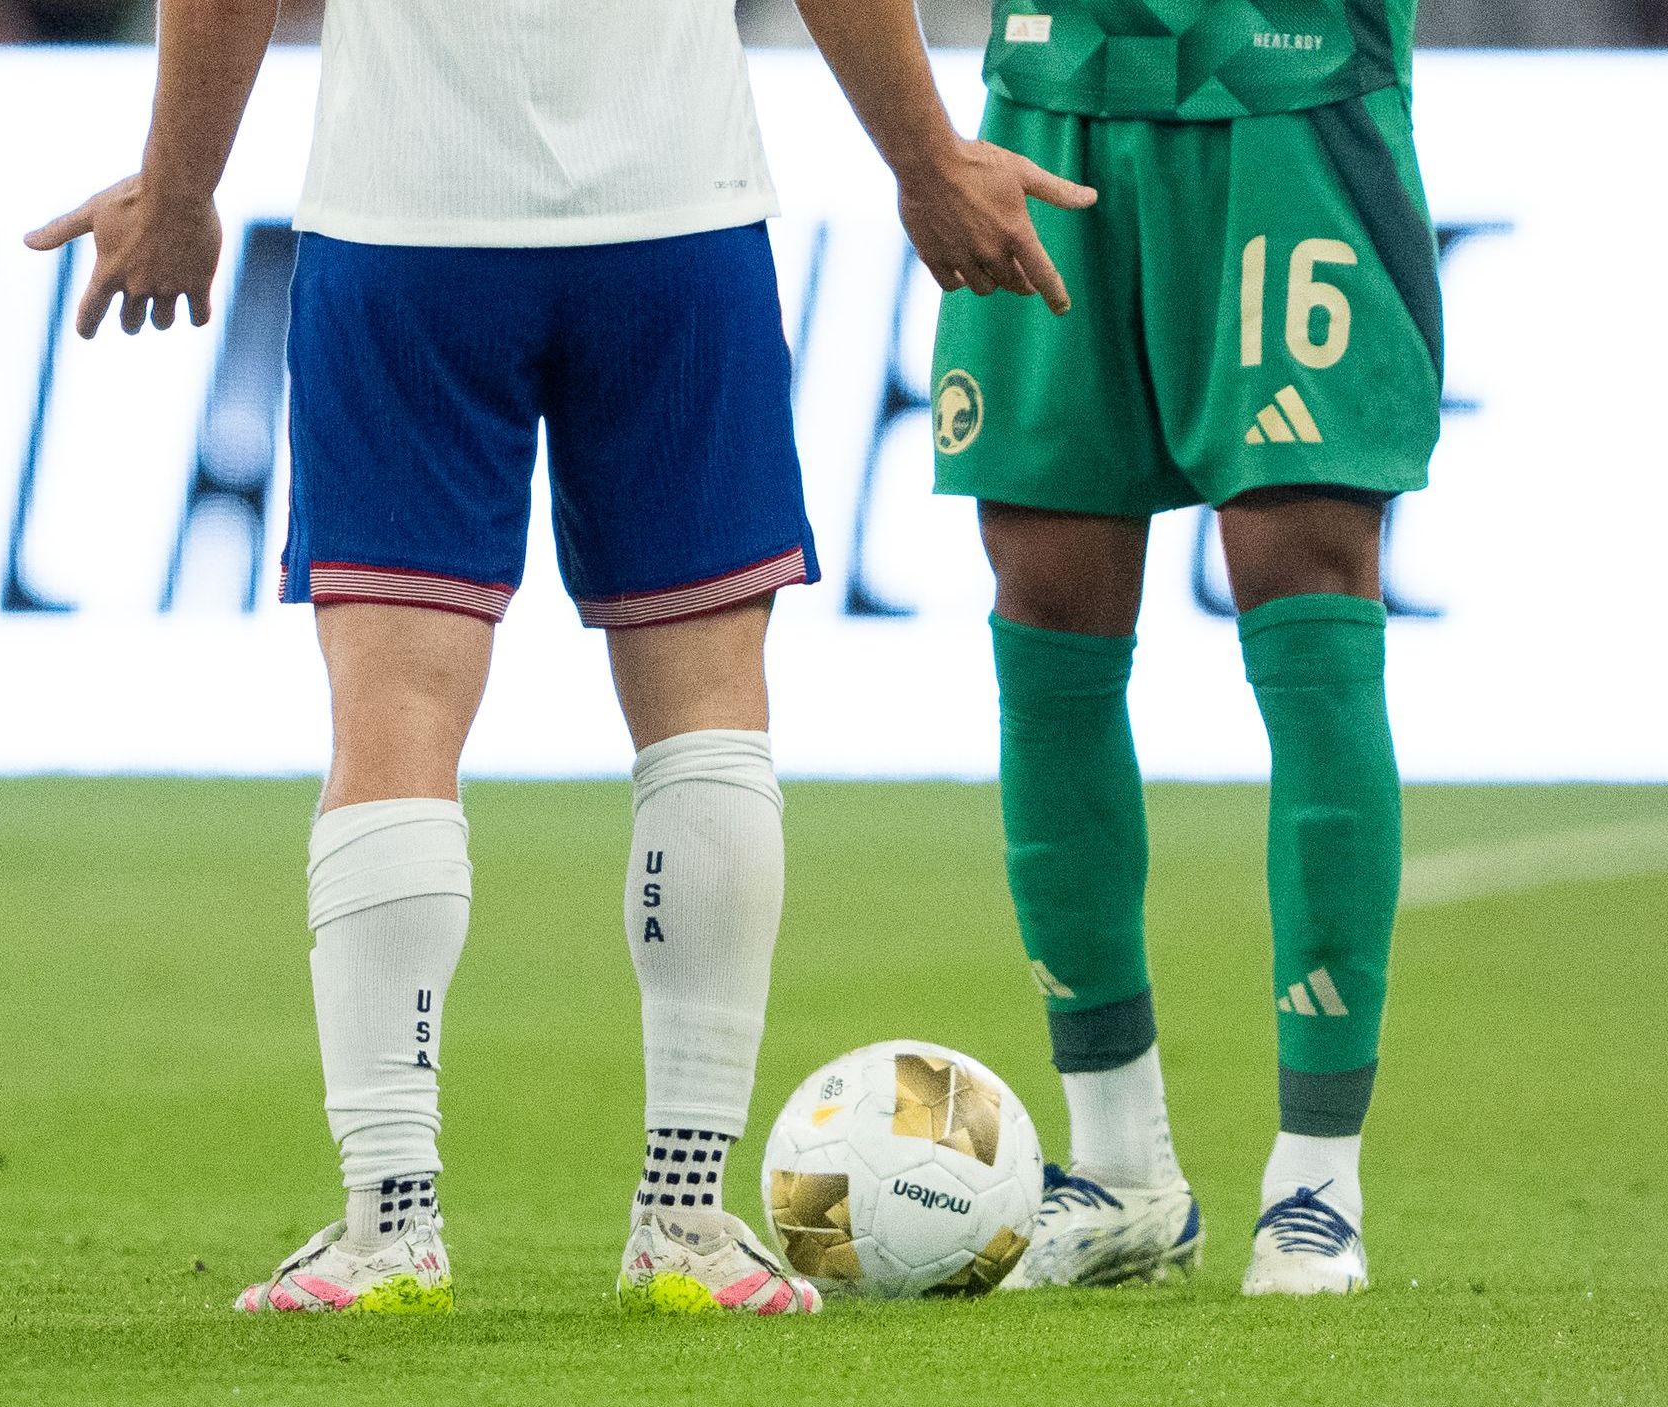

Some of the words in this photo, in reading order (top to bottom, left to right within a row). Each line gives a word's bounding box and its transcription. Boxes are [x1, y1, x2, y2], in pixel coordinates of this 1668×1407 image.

[1238, 234, 1359, 369] 16
[642, 850, 664, 942] USA
[416, 989, 432, 1068] USA
[893, 1179, 972, 1215] molten
